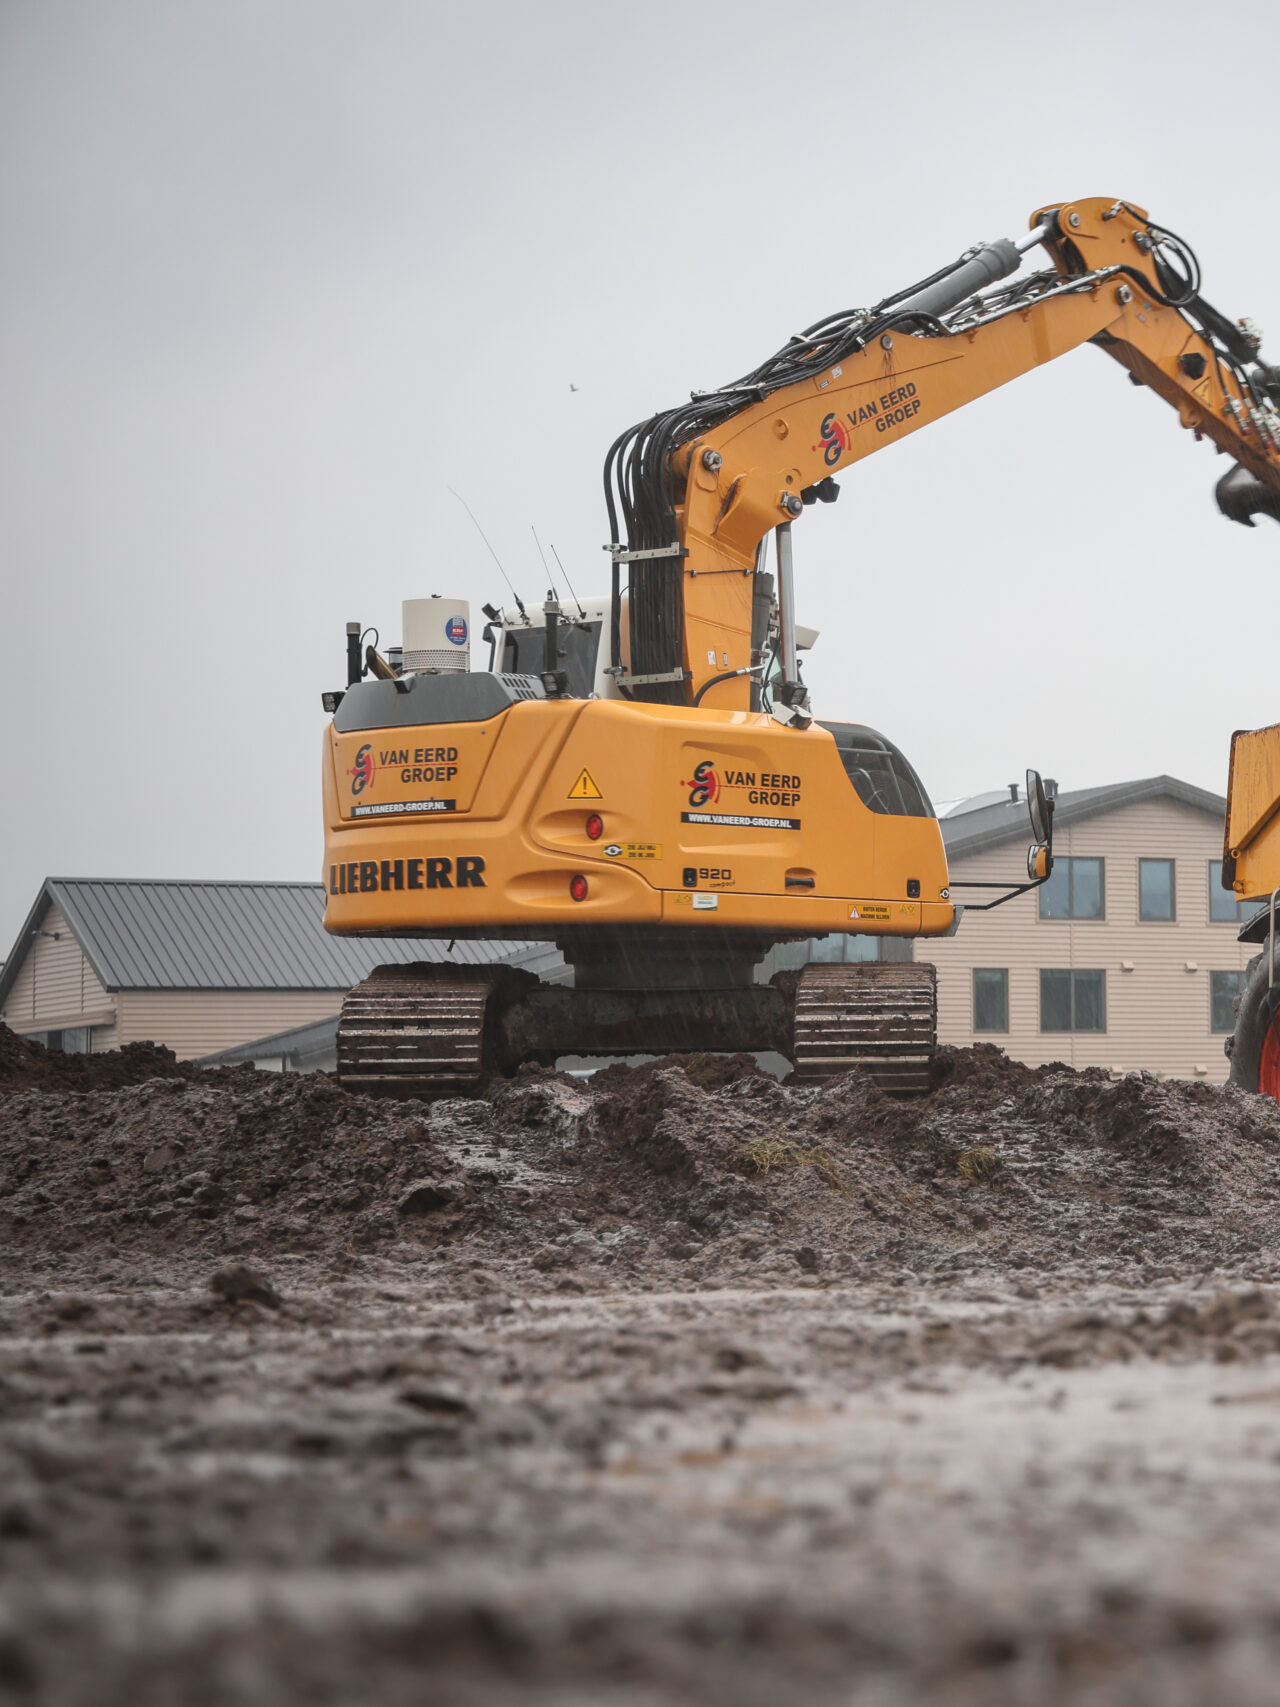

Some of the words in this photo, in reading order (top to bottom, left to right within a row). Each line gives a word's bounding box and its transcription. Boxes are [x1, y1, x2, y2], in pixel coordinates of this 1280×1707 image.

[847, 401, 878, 426] VAN
[880, 382, 917, 411] EERD
[875, 399, 921, 433] GROEP
[380, 750, 409, 766] VAN
[415, 747, 458, 763] EERD
[401, 767, 458, 783] GROEP
[724, 770, 756, 786] VAN
[761, 773, 801, 789] EERD
[748, 790, 801, 807] GROEP
[355, 801, 447, 816] WWW.VANEERD-GROEP.NL
[688, 813, 792, 829] WWW.VANEERD-GROEP.NL
[329, 856, 487, 895] LIEBHERR
[699, 868, 732, 880] 920
